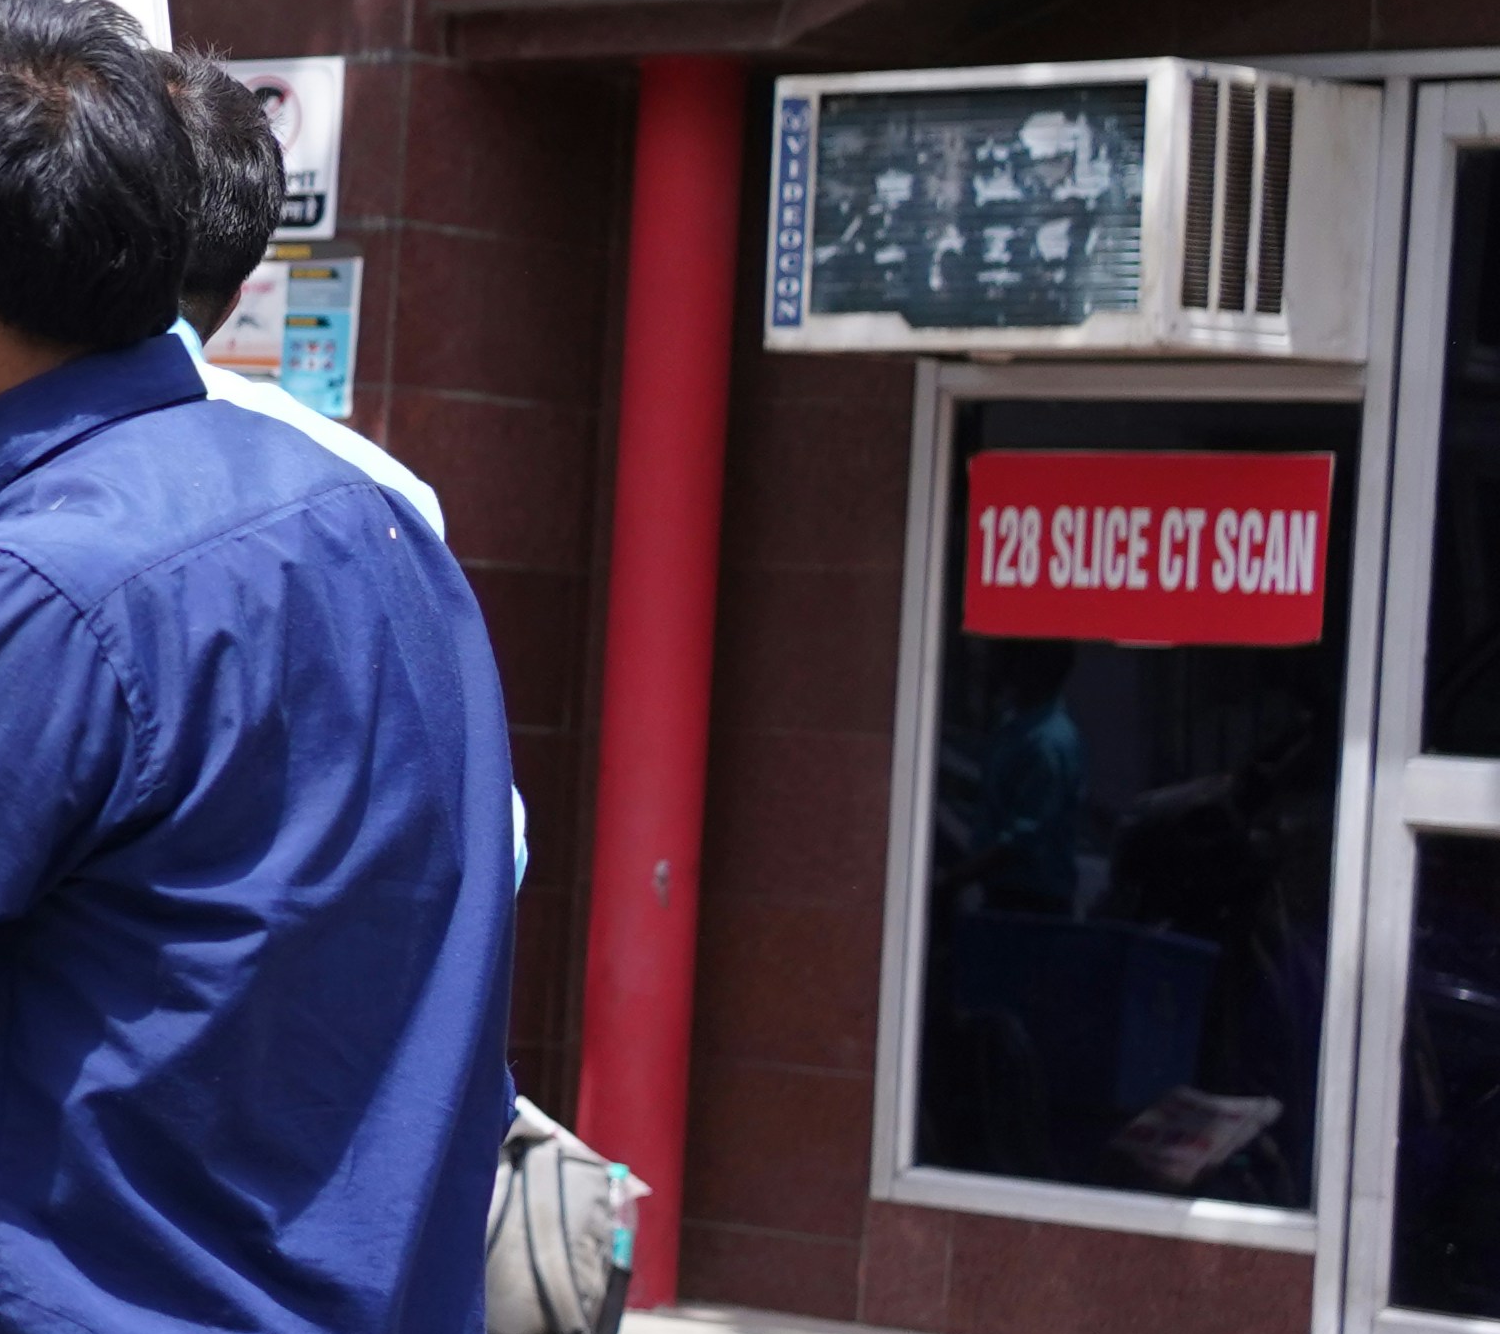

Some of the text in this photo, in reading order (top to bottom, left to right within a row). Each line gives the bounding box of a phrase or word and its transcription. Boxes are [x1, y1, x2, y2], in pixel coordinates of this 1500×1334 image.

[978, 505, 1318, 596] 128 SLICE CT SCAN
